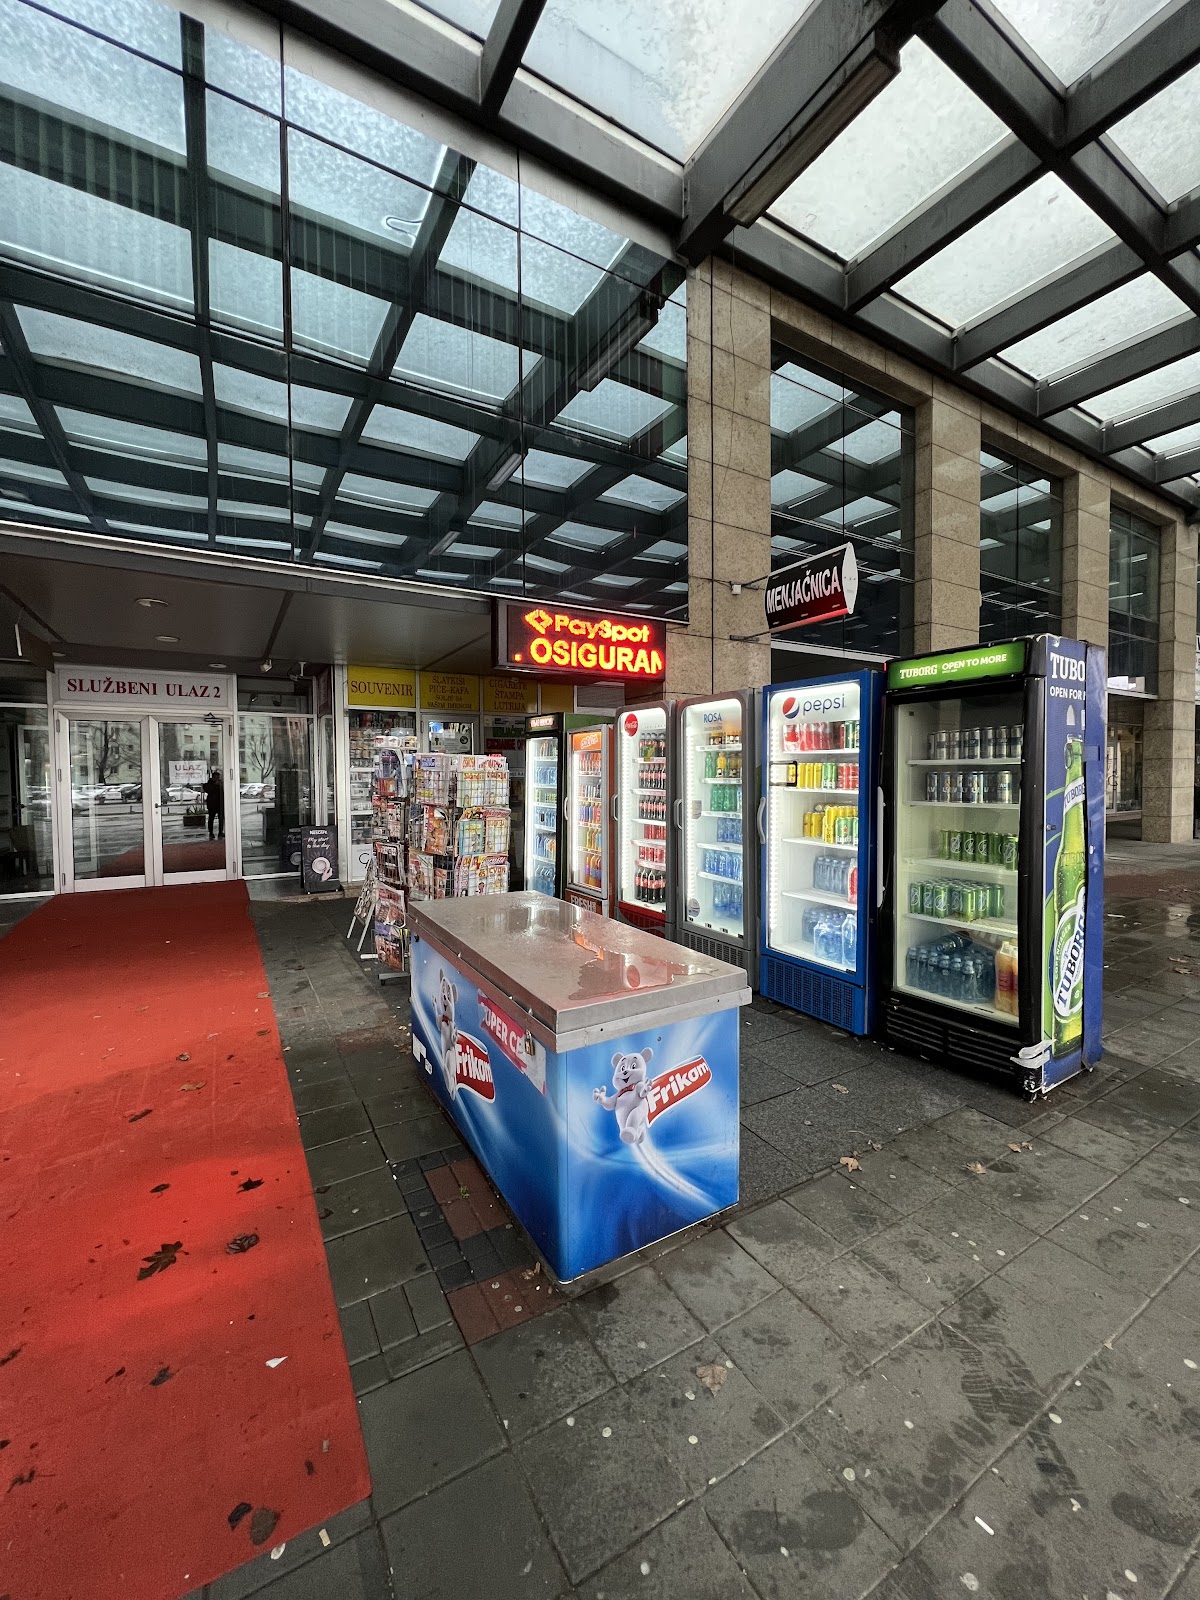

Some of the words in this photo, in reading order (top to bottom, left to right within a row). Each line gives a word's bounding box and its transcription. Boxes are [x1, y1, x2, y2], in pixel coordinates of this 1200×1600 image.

[767, 566, 841, 613] MENJAČNICA
[555, 614, 650, 643] PaySpot
[900, 664, 938, 679] TUBORG
[942, 660, 965, 671] OPEN
[966, 658, 979, 667] TO
[980, 653, 1007, 665] MORE
[1050, 652, 1086, 681] TUBO
[67, 677, 158, 696] SLUŽBENI
[166, 683, 210, 698] ULAZ
[213, 686, 221, 698] 2
[351, 680, 413, 697] SOUVENIR
[494, 689, 525, 700] ŠTAMPA
[1050, 686, 1068, 698] OPEN
[1069, 689, 1082, 700] FOR
[494, 701, 526, 711] LUTRIJA
[803, 693, 845, 716] pepsi
[703, 712, 723, 723] ROSA
[455, 1043, 493, 1083] Frikom
[647, 1062, 709, 1114] Frikom
